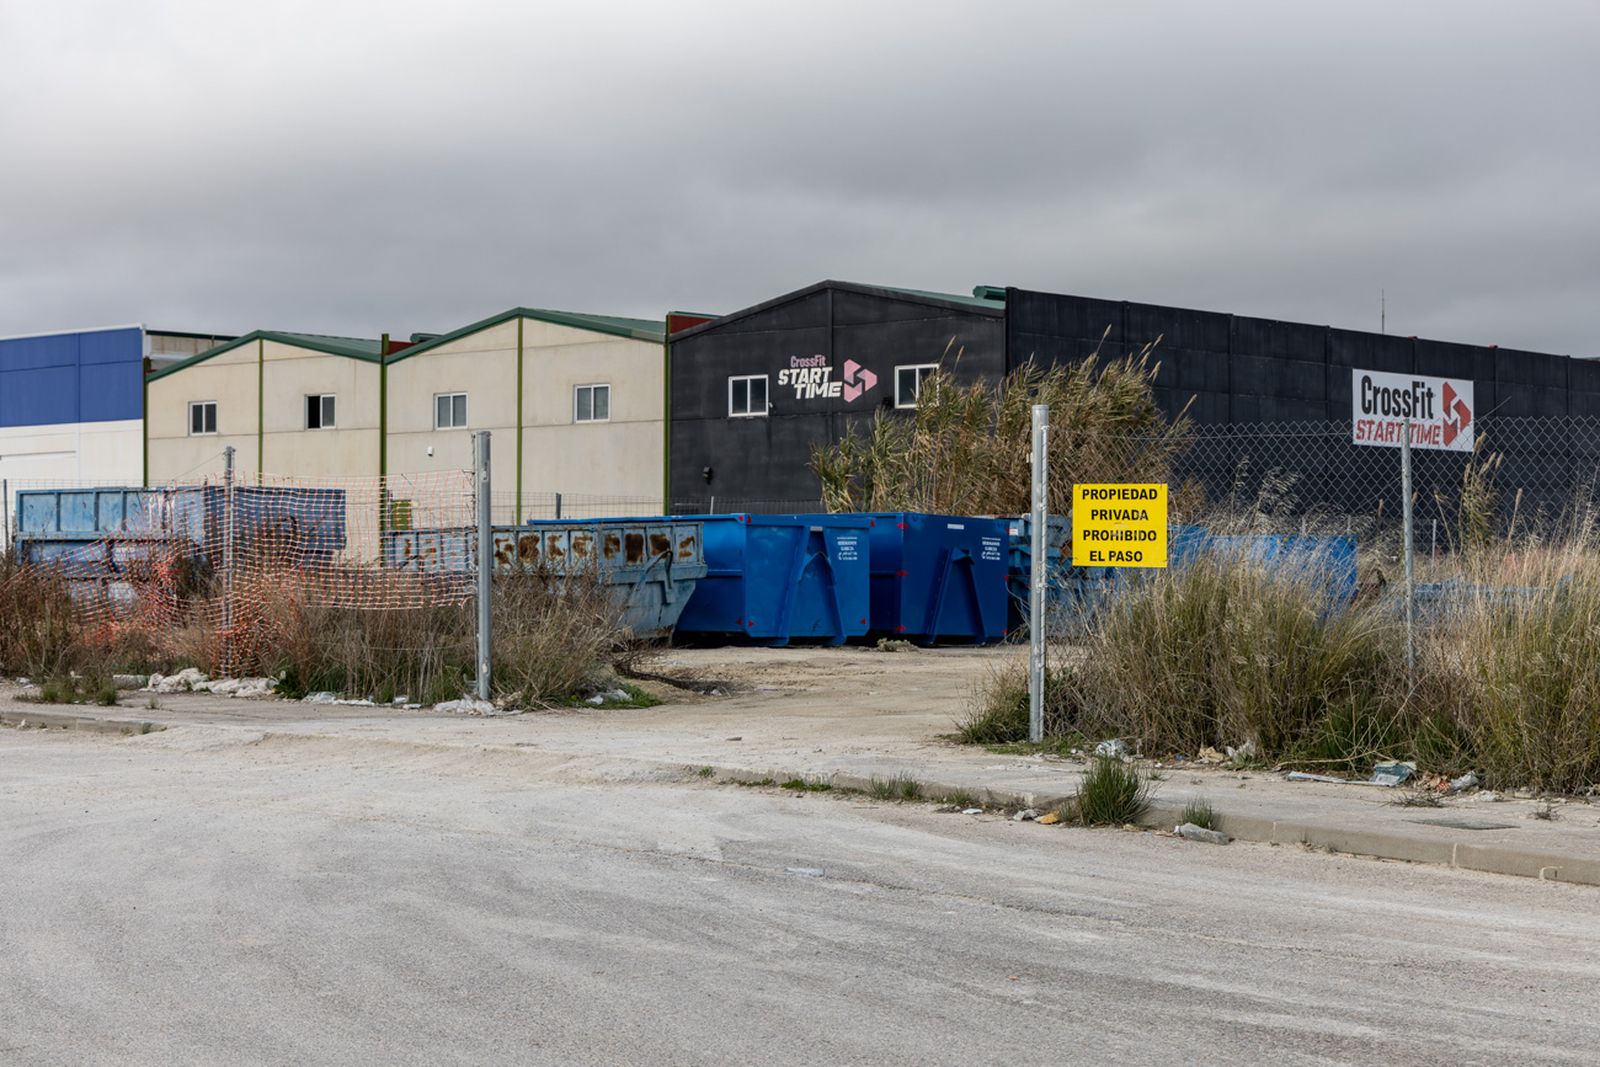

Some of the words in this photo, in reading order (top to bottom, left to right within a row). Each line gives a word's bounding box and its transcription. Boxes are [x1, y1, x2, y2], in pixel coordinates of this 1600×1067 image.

[790, 354, 826, 368] CrossFit
[778, 367, 833, 385] START
[794, 381, 843, 400] TIME
[1361, 375, 1435, 419] CrossFit
[1356, 419, 1404, 443] START
[1408, 423, 1441, 445] TIME
[1082, 488, 1158, 500] PROPIEDAD
[1091, 509, 1149, 521] PRIVADA
[1083, 530, 1157, 541] PROHIBIDO
[1089, 550, 1106, 562] EL
[1108, 550, 1143, 562] PASO
